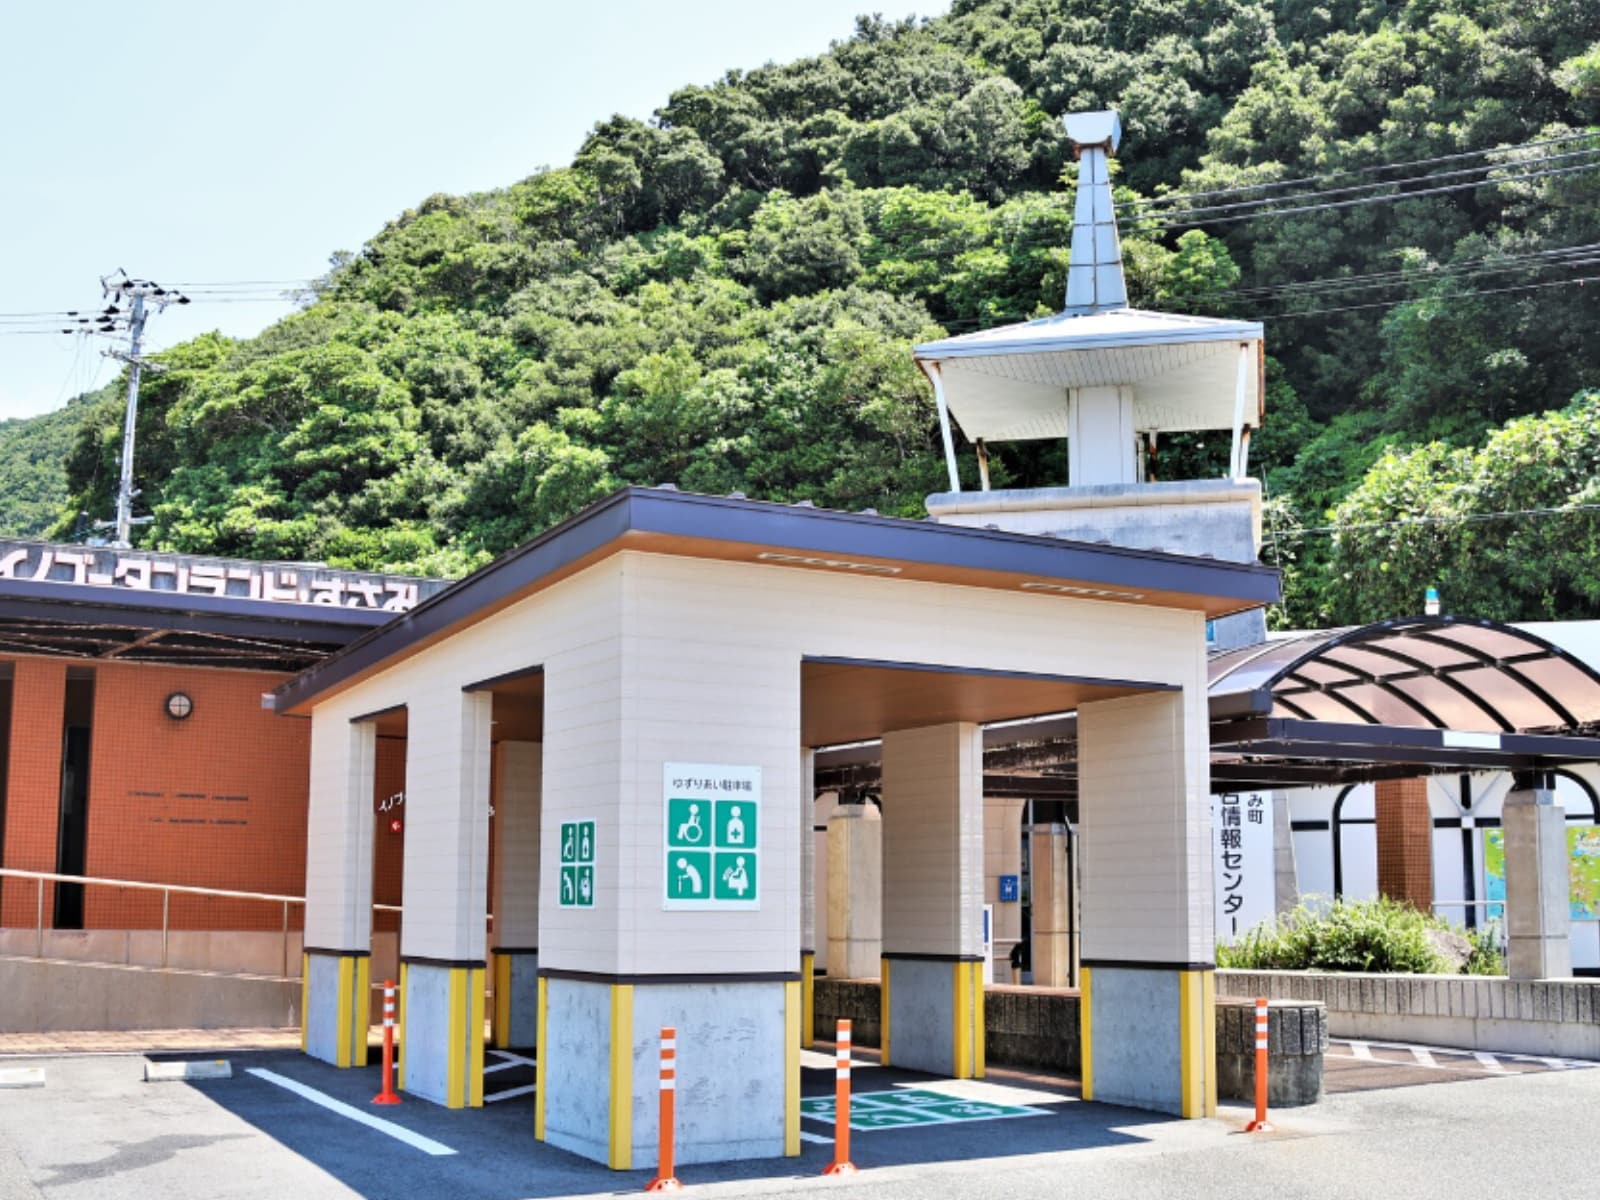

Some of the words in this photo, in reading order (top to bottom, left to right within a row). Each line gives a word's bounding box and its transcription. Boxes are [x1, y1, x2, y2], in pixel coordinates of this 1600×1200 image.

[672, 778, 752, 791] ゆずりあい駐車場
